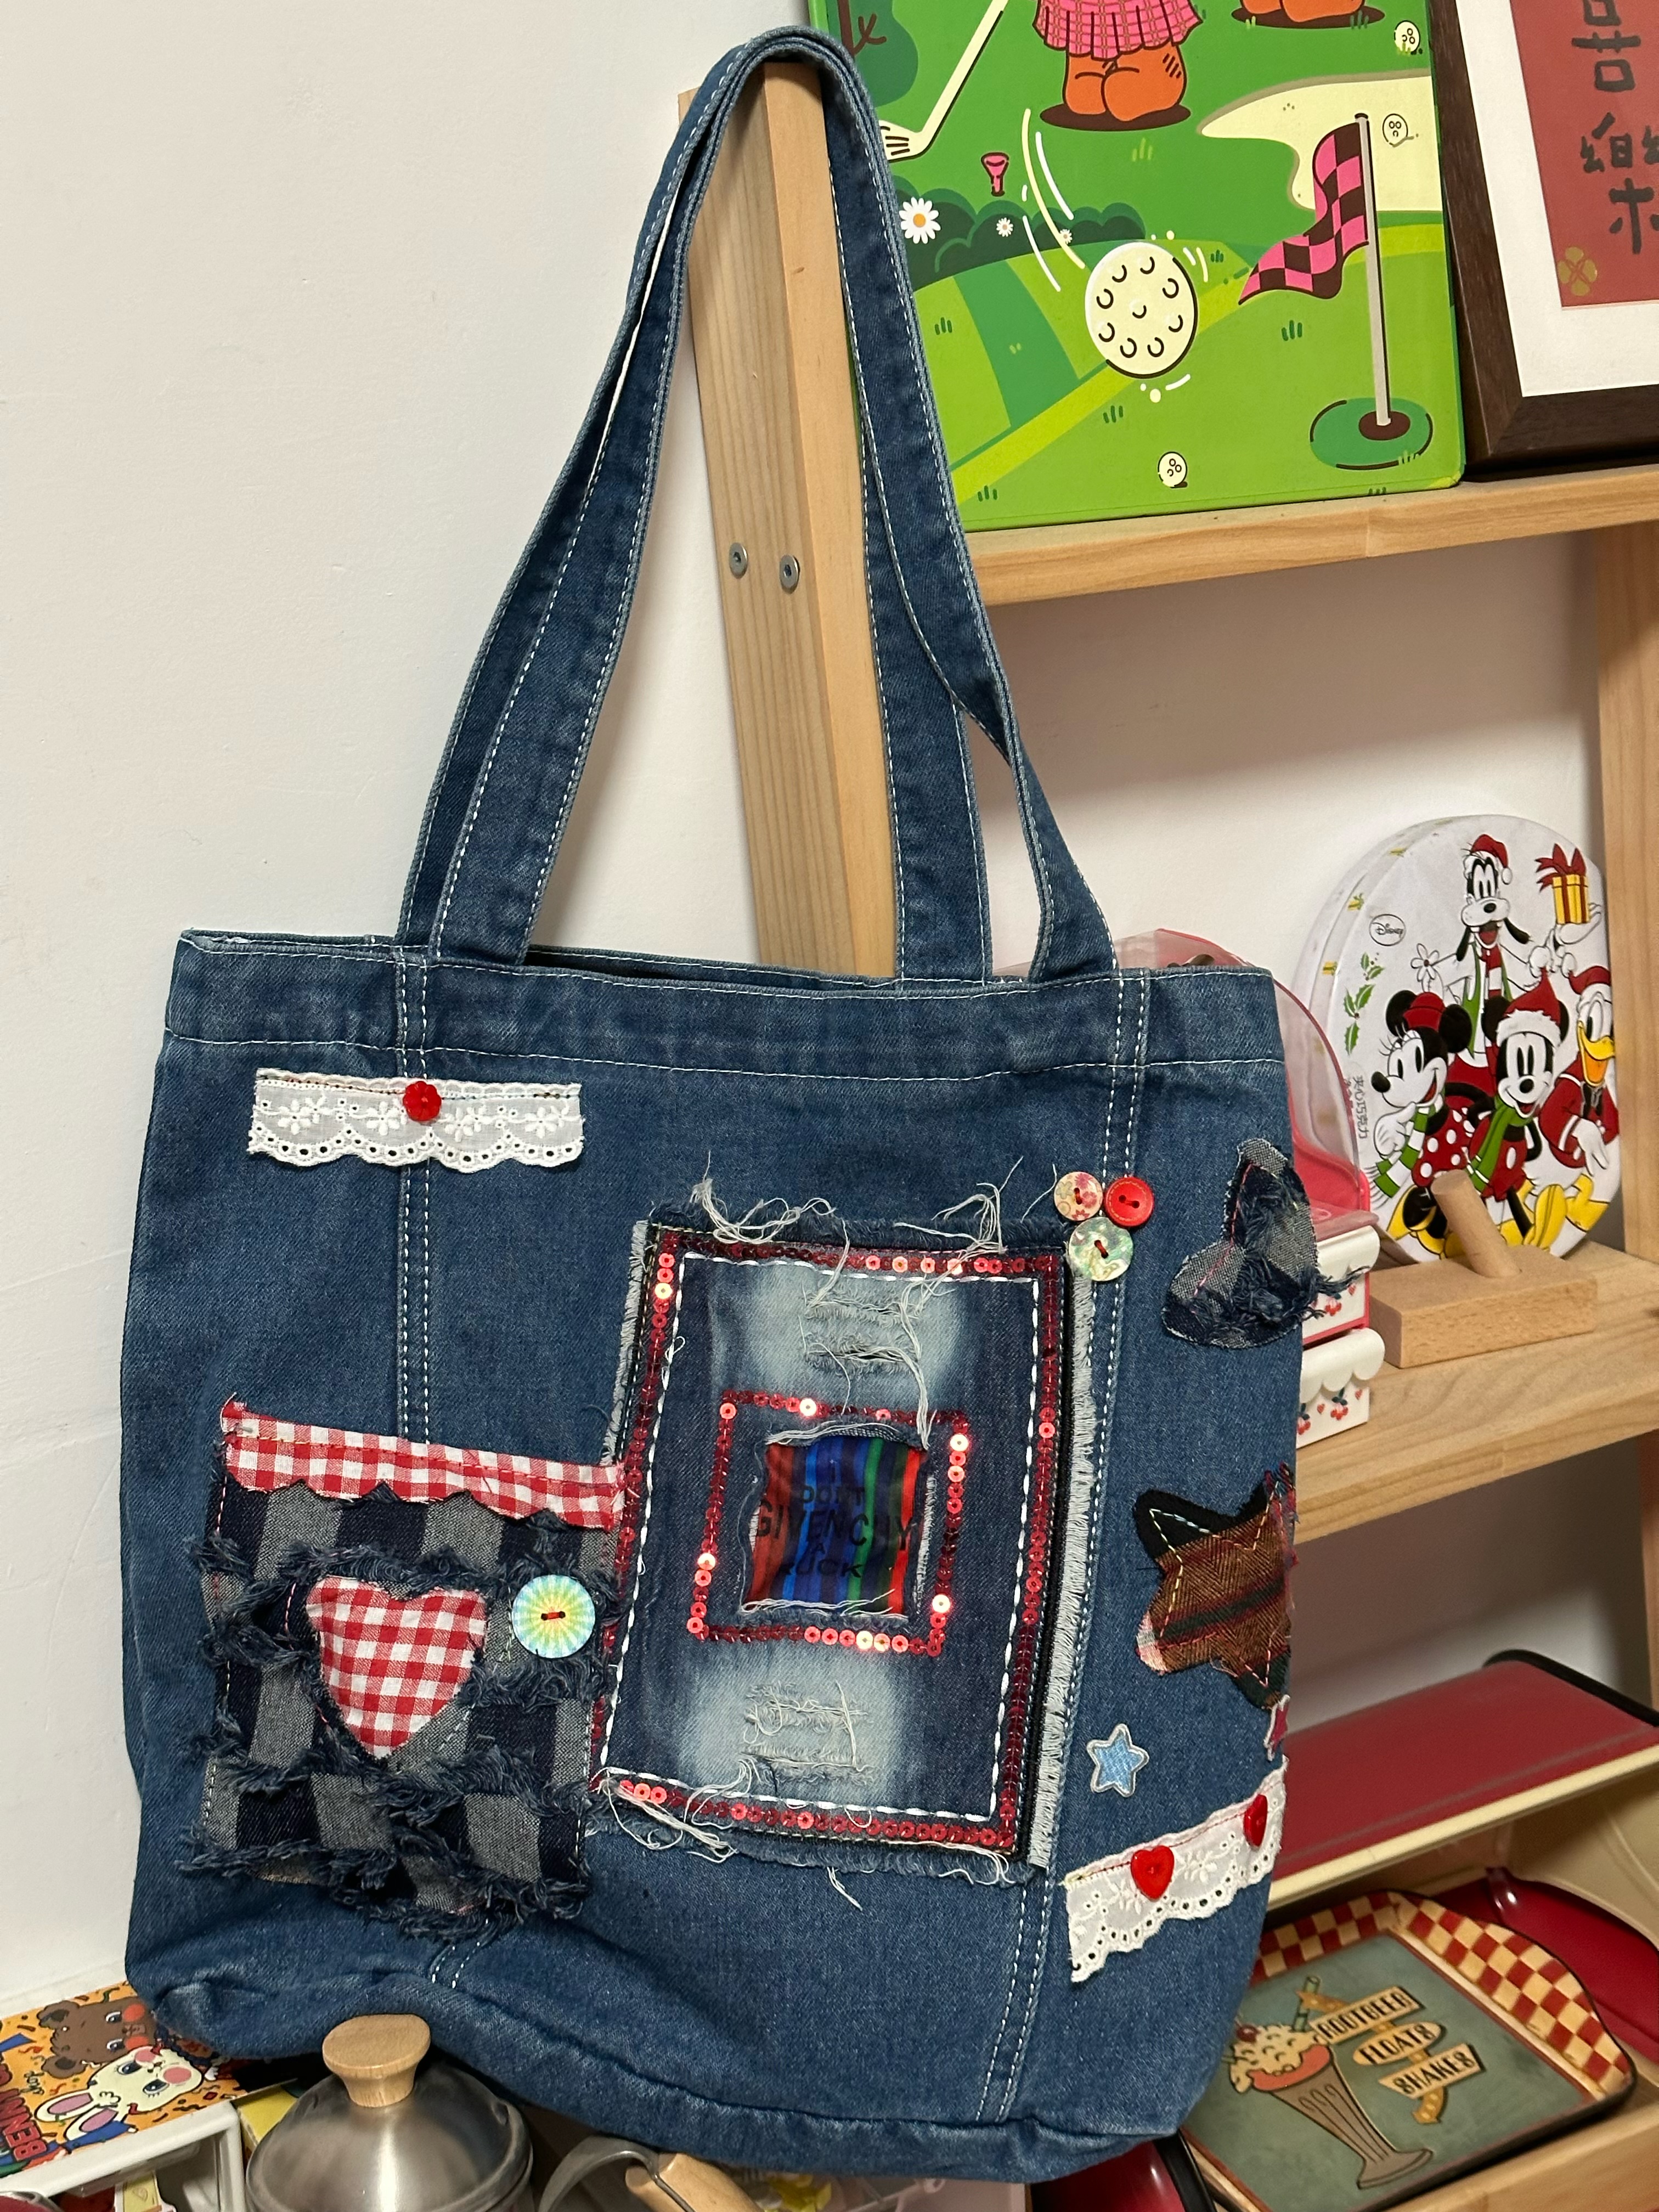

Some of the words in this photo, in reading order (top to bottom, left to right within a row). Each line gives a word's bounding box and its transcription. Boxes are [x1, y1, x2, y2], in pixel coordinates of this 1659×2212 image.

[1317, 1991, 1413, 2039] ROOTBEER
[1359, 2024, 1434, 2064] FLOATS
[1393, 2050, 1475, 2095] SHAKES
